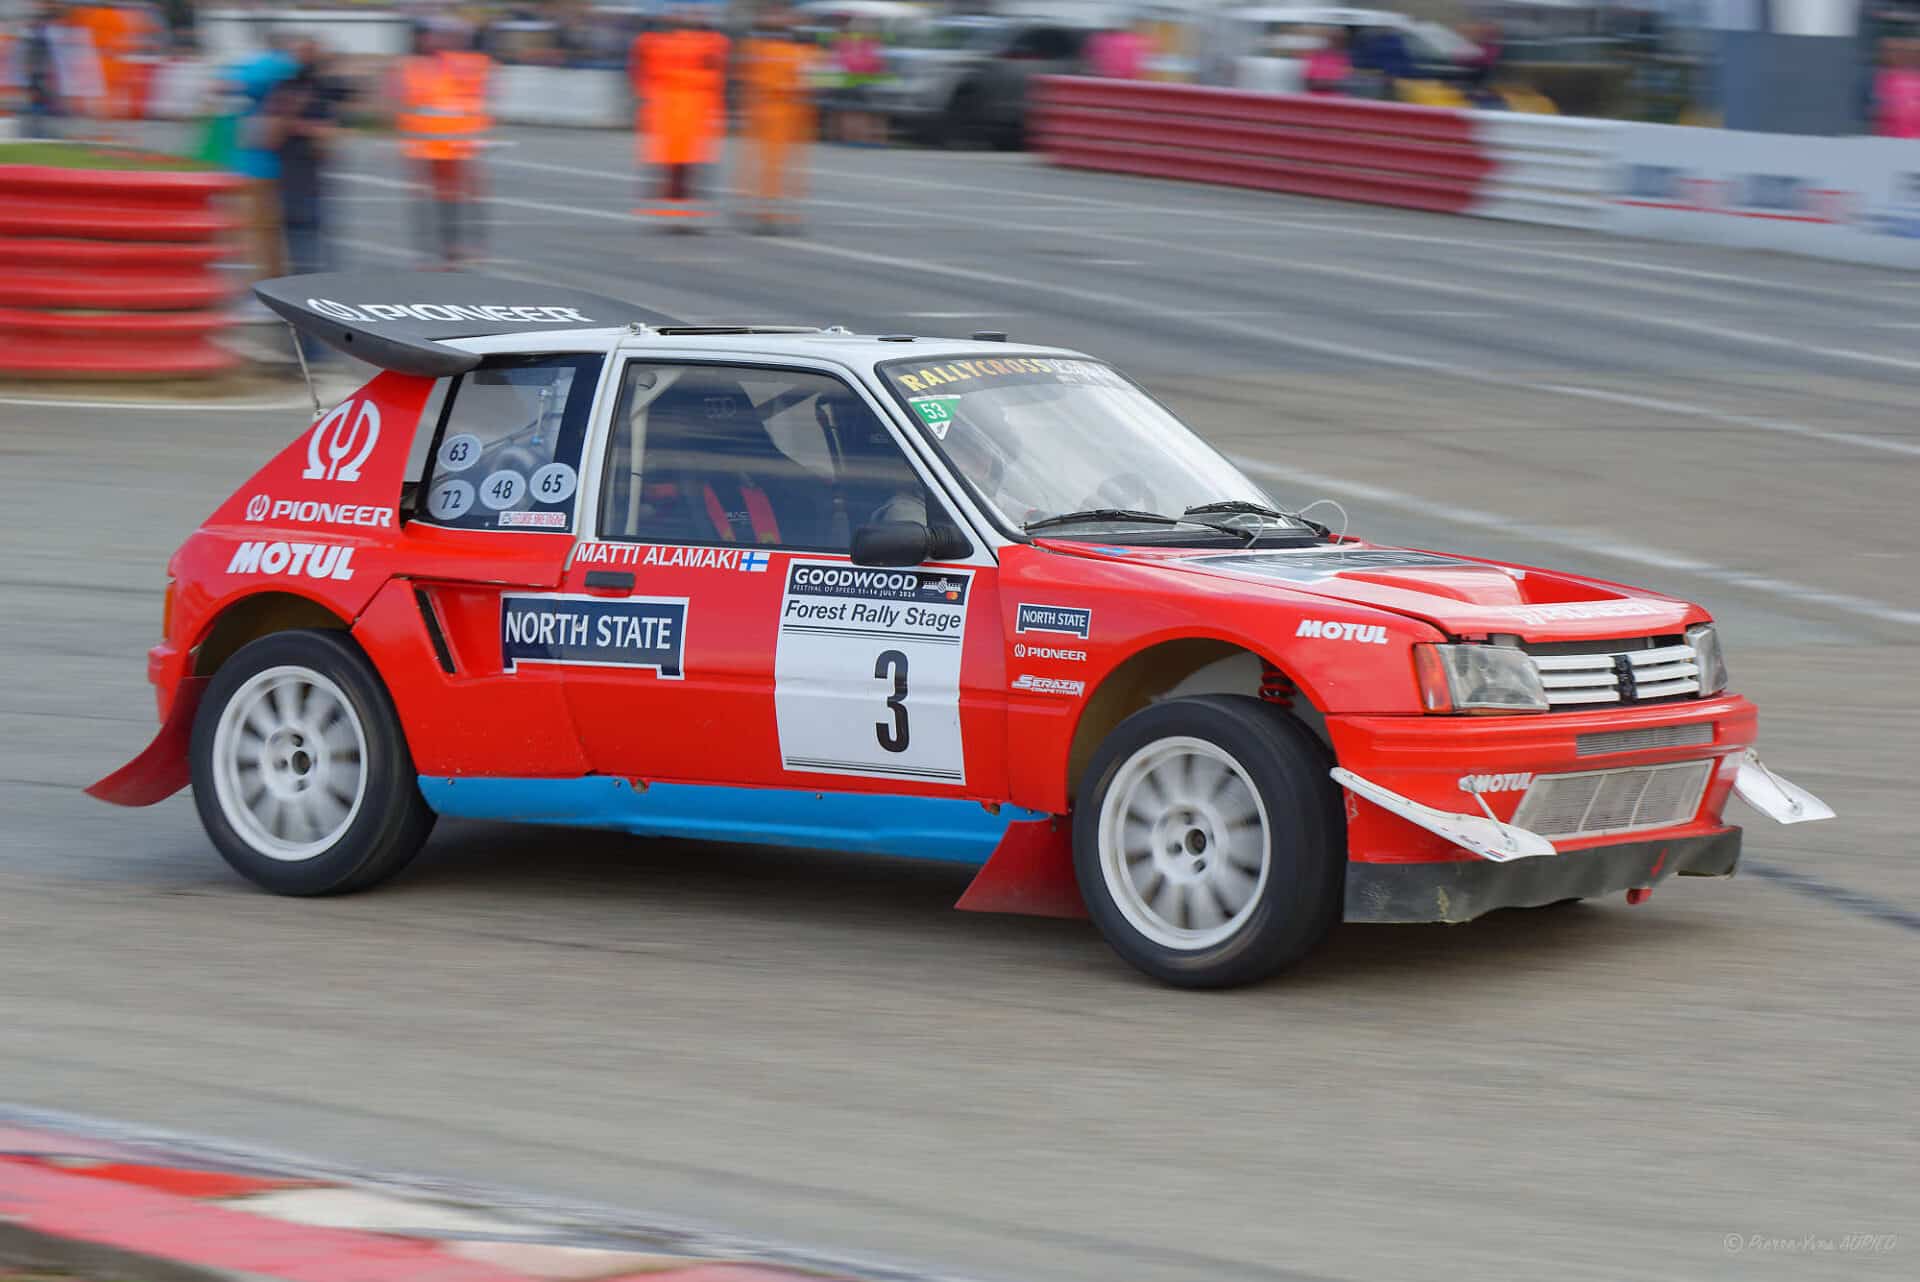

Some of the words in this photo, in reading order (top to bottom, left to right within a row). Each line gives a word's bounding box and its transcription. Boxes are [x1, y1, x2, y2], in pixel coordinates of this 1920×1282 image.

[357, 303, 596, 322] PIONEER
[898, 358, 1053, 392] RALLYCROSS
[920, 402, 948, 420] 53
[449, 442, 469, 462] 63
[491, 479, 513, 500] 48
[541, 474, 564, 494] 65
[441, 488, 461, 510] 72
[270, 500, 393, 528] PIONEER
[225, 541, 355, 581] MOTUL
[576, 543, 640, 565] MATTI
[642, 546, 739, 570] ALAMAKI
[794, 568, 918, 591] GOODWOOD
[792, 584, 821, 593] FESTIVAL
[824, 586, 834, 594] OF
[836, 586, 856, 595] SPEED
[879, 589, 897, 598] JULY
[784, 599, 847, 621] Forest
[850, 603, 900, 628] Rally
[904, 607, 961, 632] Stage
[1022, 609, 1056, 626] NORTH
[1057, 612, 1086, 628] STATE
[505, 611, 589, 647] NORTH
[596, 615, 672, 651] STATE
[1295, 619, 1389, 645] MOTUL
[1027, 646, 1087, 662] PIONEER
[873, 649, 909, 753] 3
